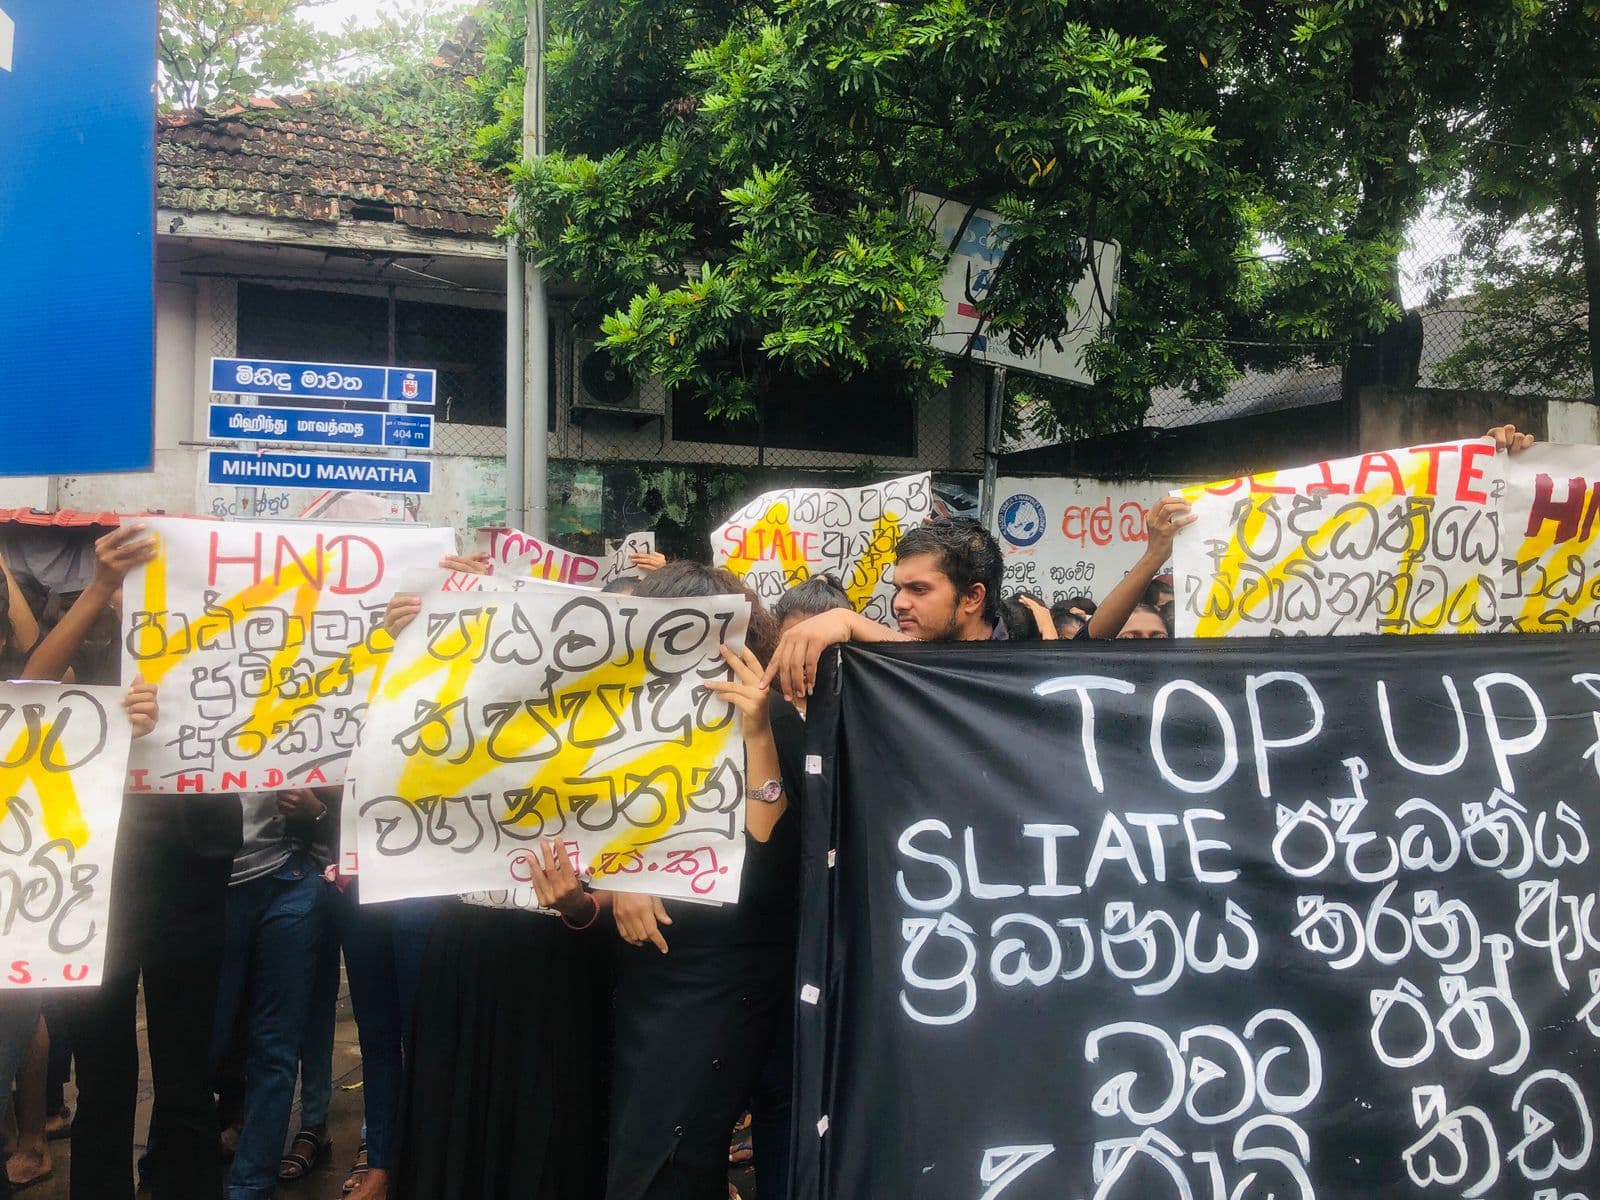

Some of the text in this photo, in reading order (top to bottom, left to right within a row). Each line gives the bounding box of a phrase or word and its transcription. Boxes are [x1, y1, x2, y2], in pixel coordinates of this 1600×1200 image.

[235, 365, 363, 391] මිහිඳු මාවත
[229, 412, 364, 437] மிஹிந்து மாவத்தை
[392, 429, 425, 440] 404 m
[222, 459, 418, 483] MIHINDU MAWATHA
[1061, 496, 1114, 548] අල්
[208, 531, 385, 595] HND
[720, 525, 823, 563] SLIATE
[1033, 670, 1325, 798] TOP
[1377, 671, 1548, 793] UP
[898, 807, 1241, 911] SLIATE
